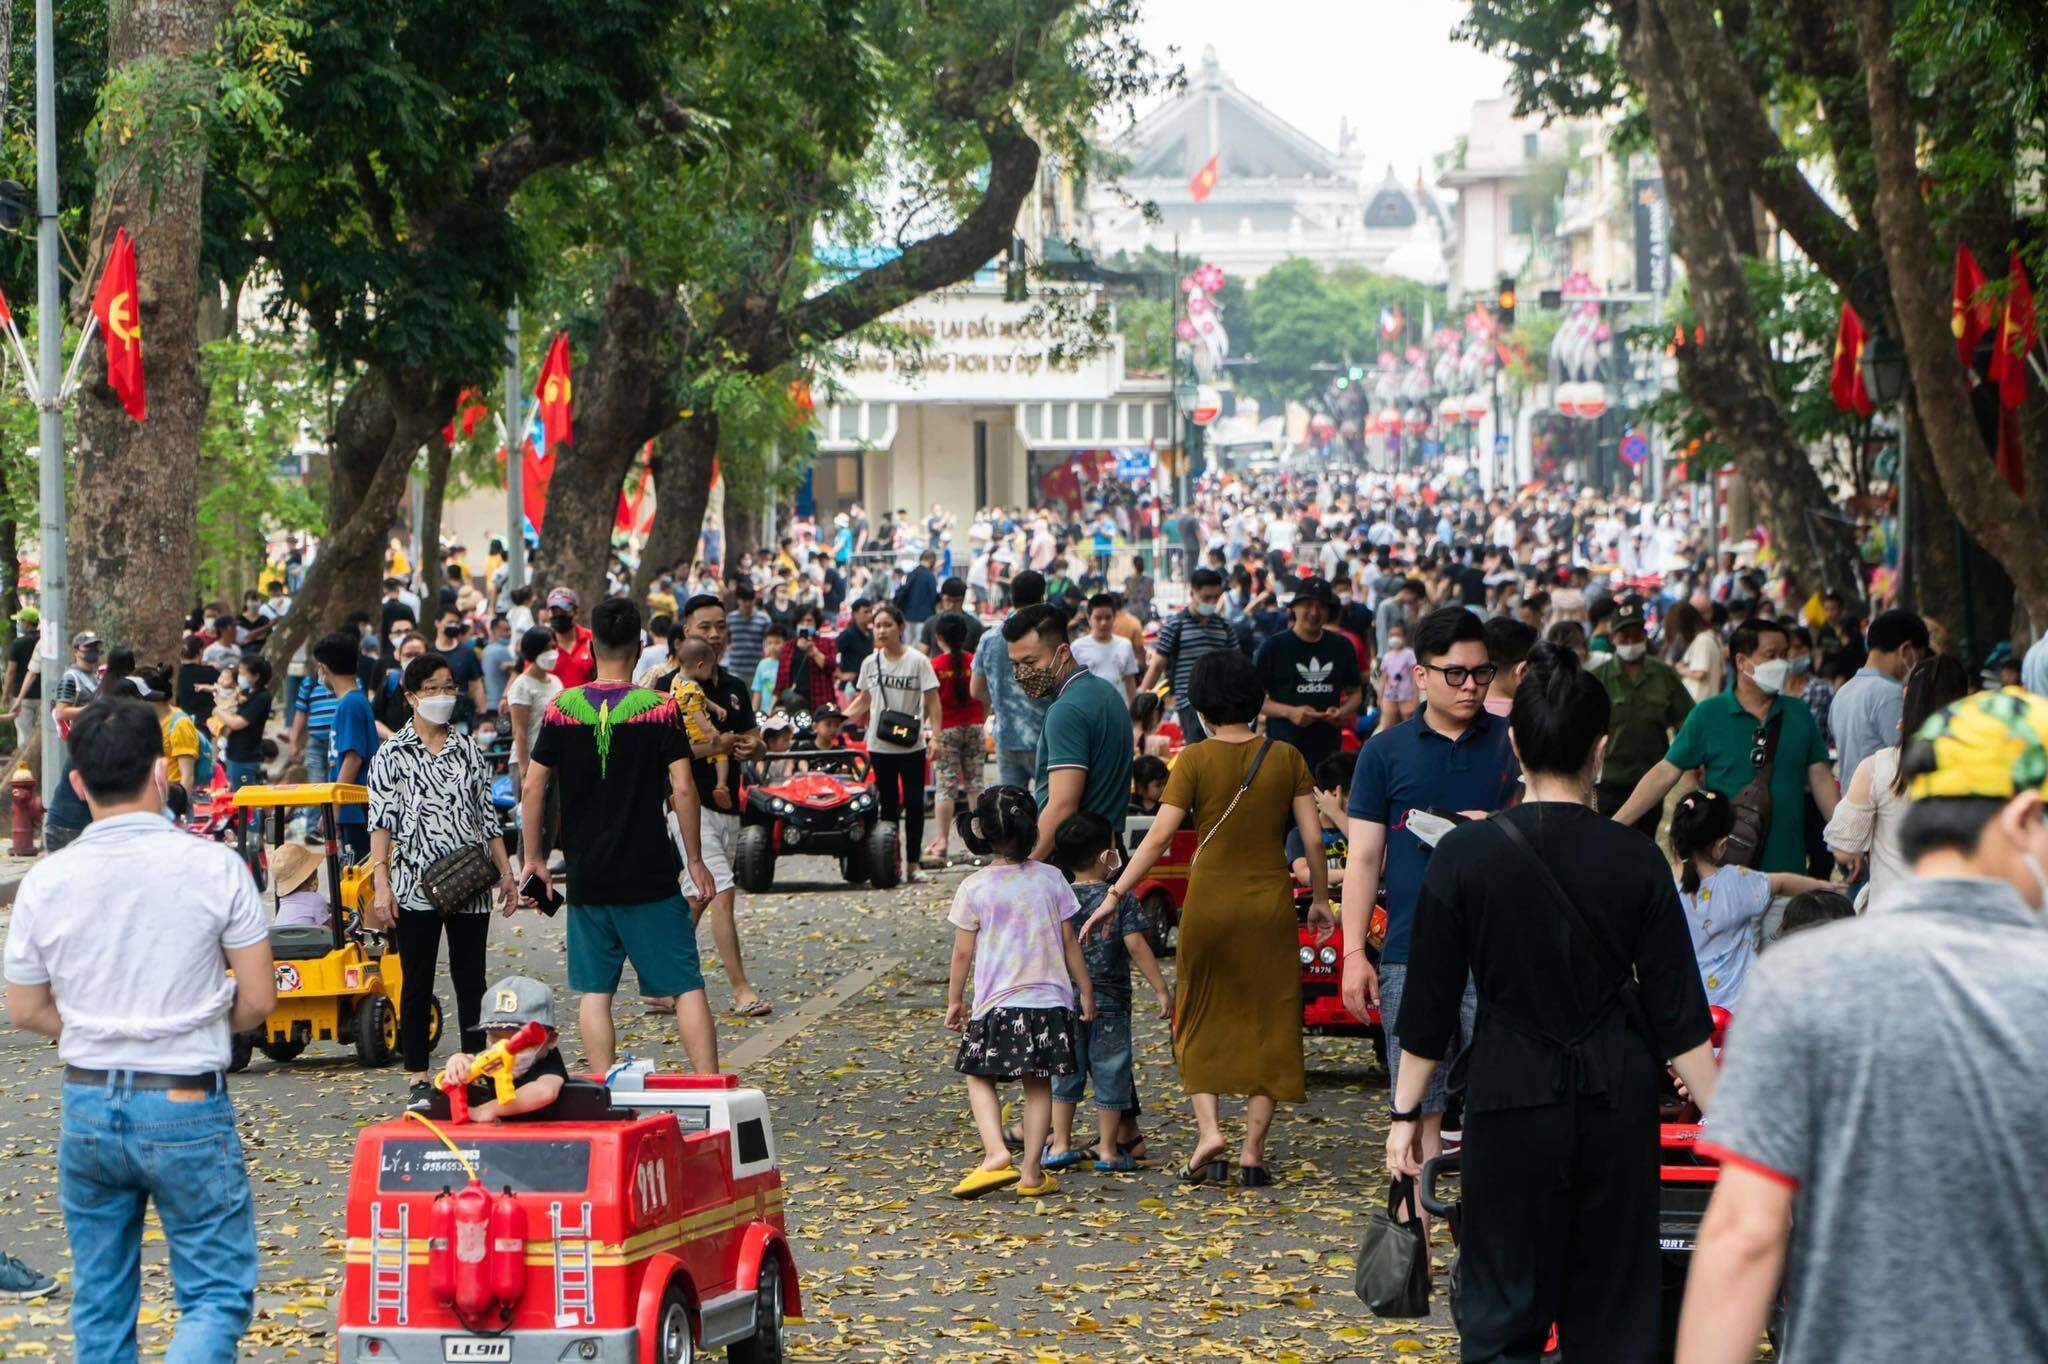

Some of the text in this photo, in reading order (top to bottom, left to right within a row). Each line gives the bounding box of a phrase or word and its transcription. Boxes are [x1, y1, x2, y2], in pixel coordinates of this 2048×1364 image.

[1296, 682, 1334, 693] adidas
[637, 1158, 668, 1215] 911
[452, 1344, 504, 1355] LL911
